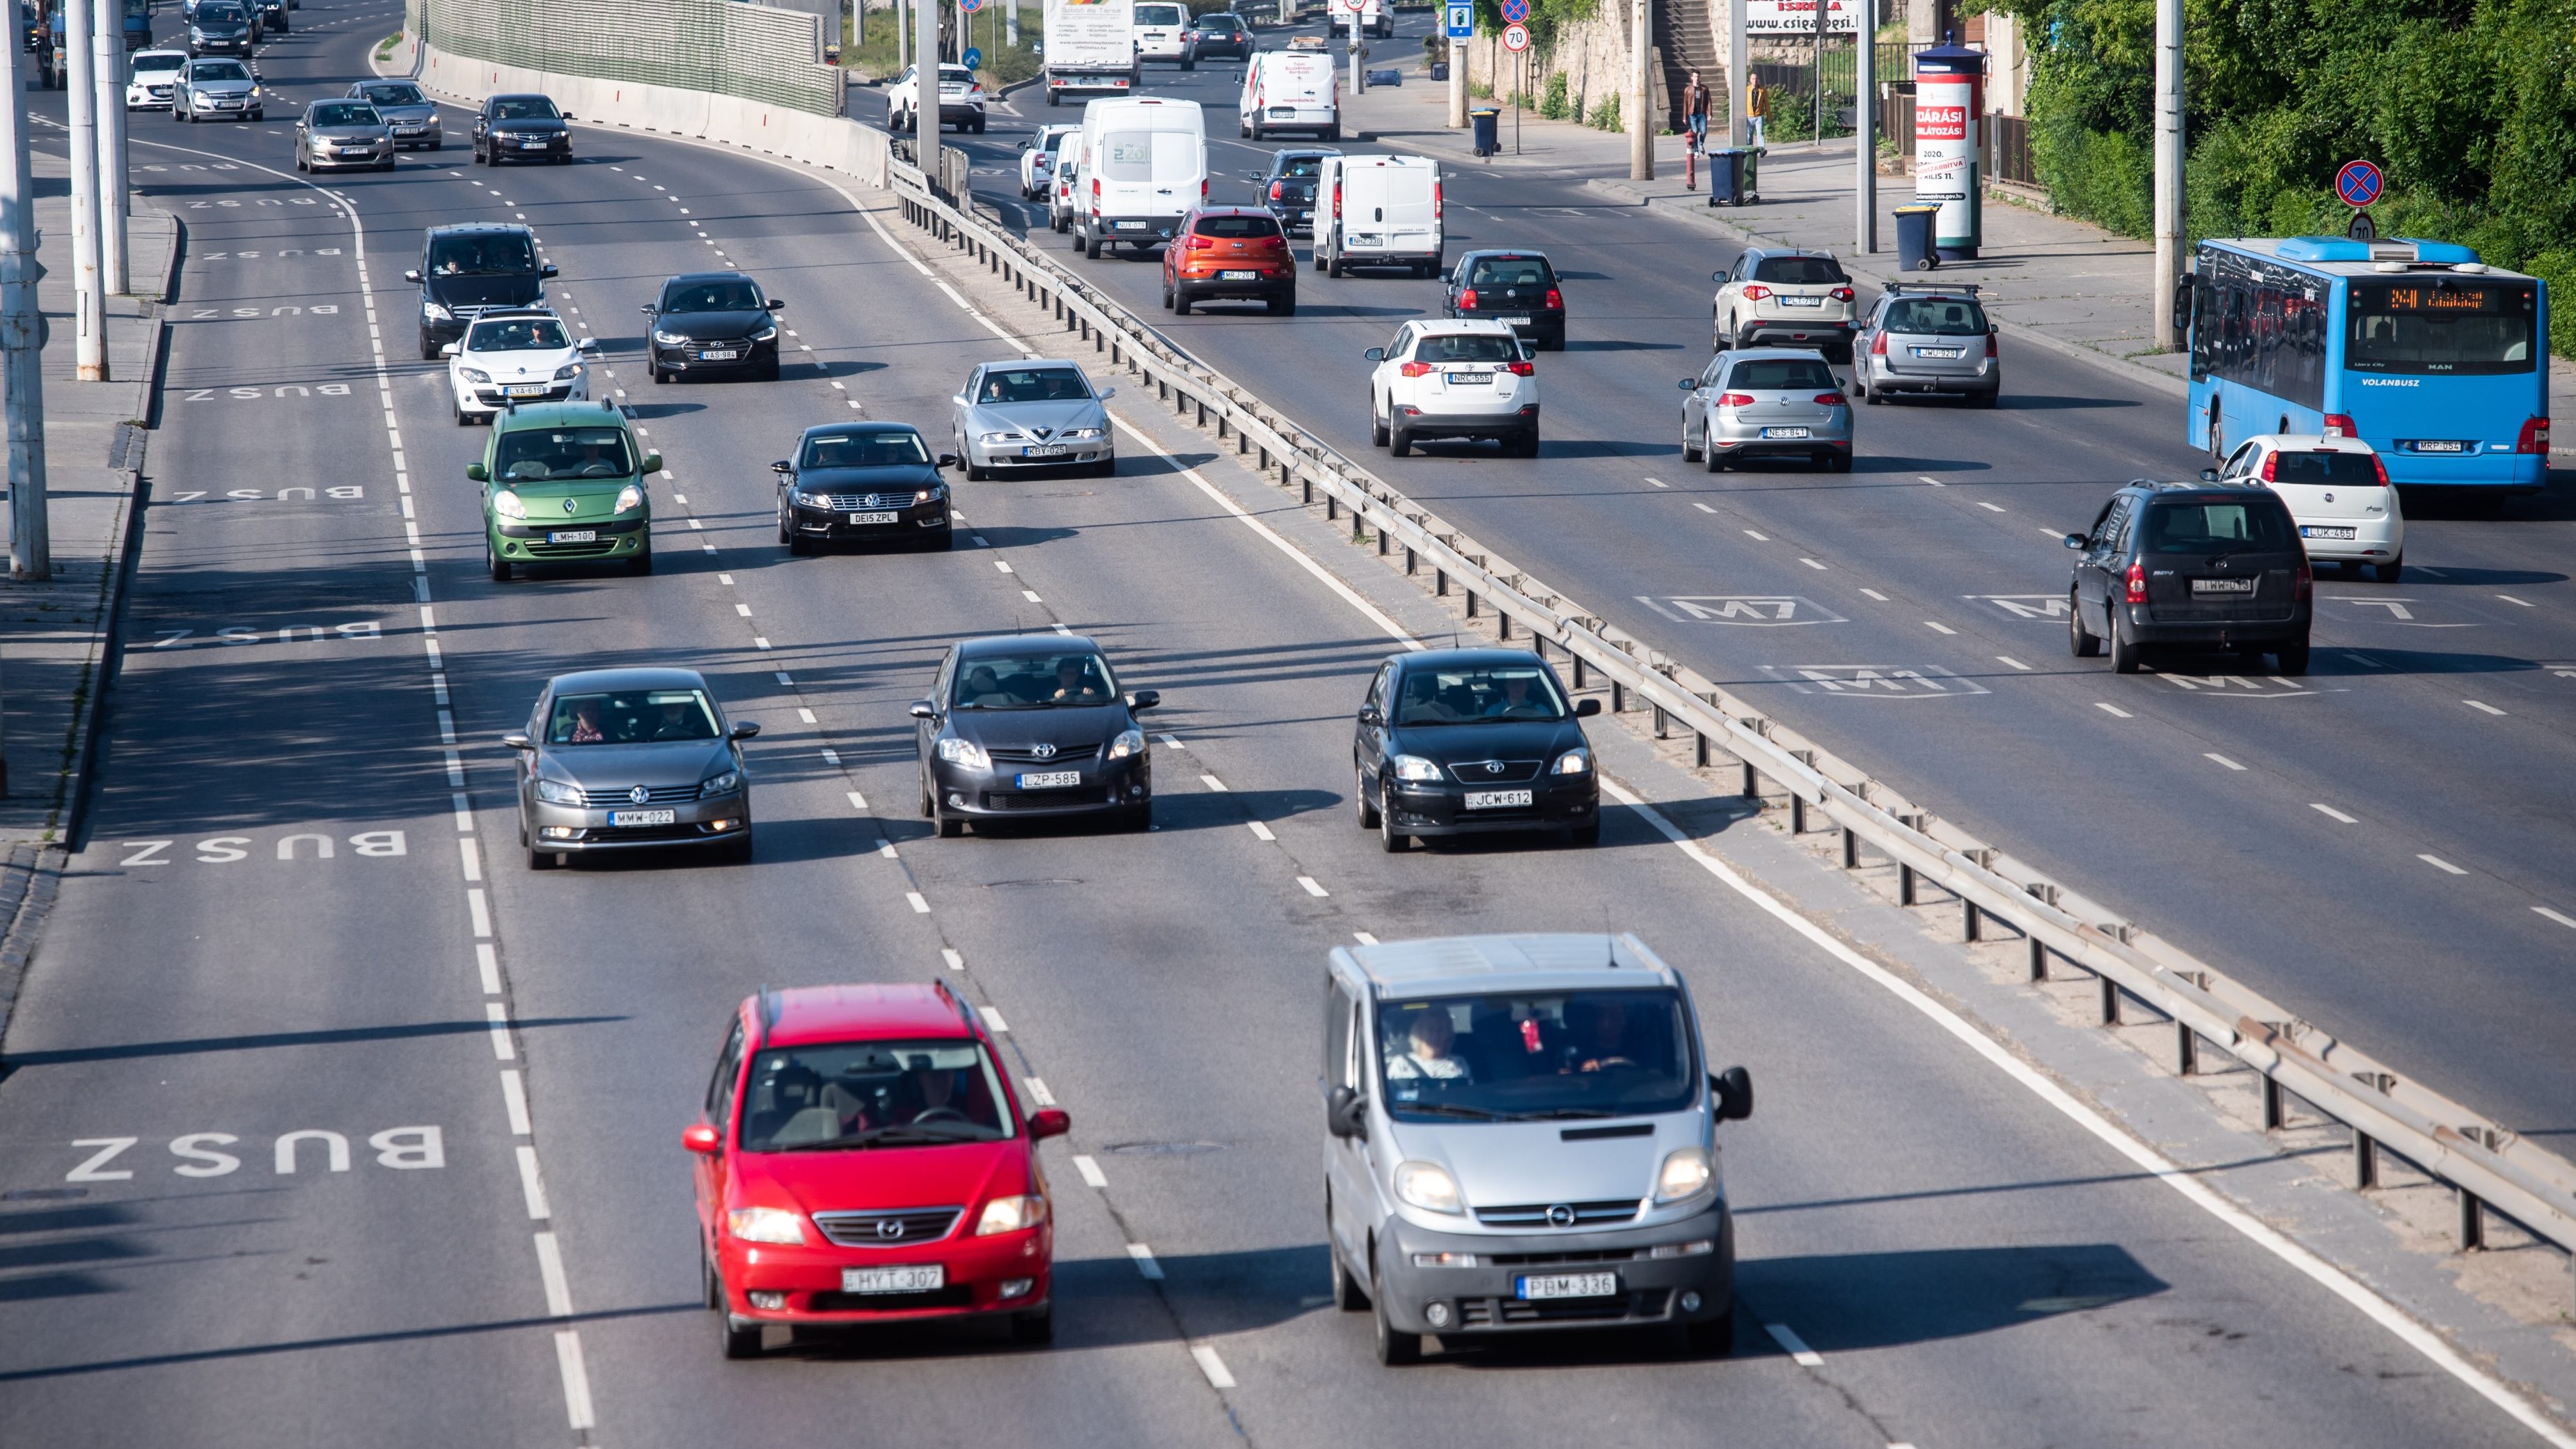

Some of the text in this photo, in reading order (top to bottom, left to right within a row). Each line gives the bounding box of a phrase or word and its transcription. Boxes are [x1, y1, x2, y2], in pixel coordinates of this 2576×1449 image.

[1777, 2, 1842, 11] ISKOA
[1509, 32, 1523, 43] 70
[186, 198, 317, 208] BUSZ
[2355, 227, 2369, 238] 70
[203, 248, 341, 260] BUSZ
[192, 305, 338, 318] BUSZ
[1922, 348, 1955, 357] JWU-929
[184, 384, 351, 401] BUSZ
[1029, 446, 1065, 455] KBV-025
[2420, 441, 2459, 450] MRP-054
[173, 485, 363, 505] BUSZ
[876, 514, 892, 522] ZPL
[553, 532, 595, 542] LMH-100
[2309, 527, 2352, 537] LUK-465
[1672, 601, 1796, 620] M7
[154, 620, 382, 648] BUSZ
[1798, 670, 1947, 691] M1
[1024, 773, 1077, 786] LZP-585
[1475, 792, 1530, 806] JCW-612
[617, 812, 670, 824] MMW-022
[120, 830, 407, 867] BUSZ
[65, 1125, 446, 1182] BUSZ
[858, 1269, 940, 1288] HYT-307
[1529, 1275, 1612, 1295] PBM-336
